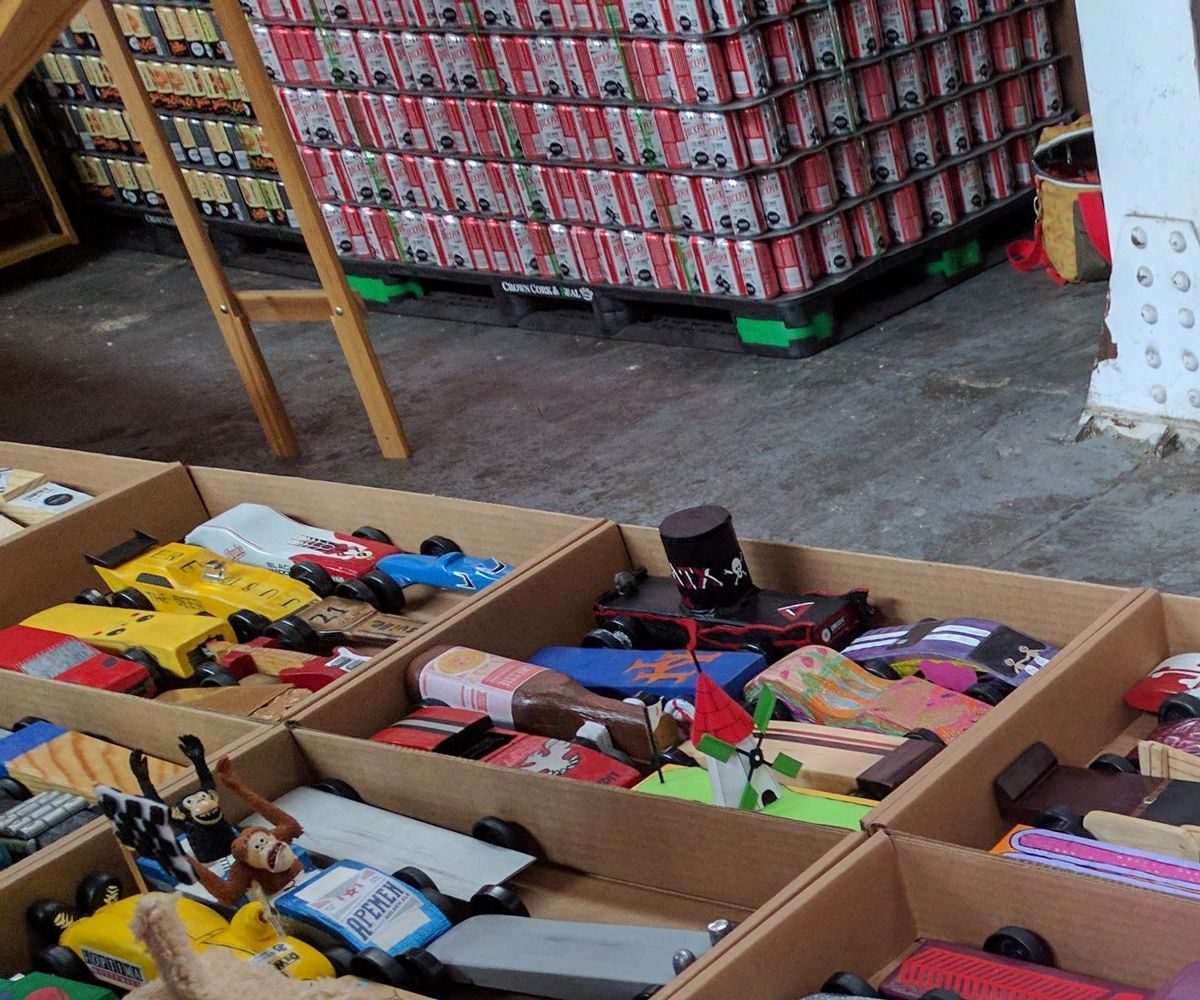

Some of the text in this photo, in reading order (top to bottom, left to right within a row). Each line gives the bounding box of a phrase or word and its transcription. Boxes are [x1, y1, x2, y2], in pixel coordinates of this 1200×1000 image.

[501, 281, 530, 293] CROWN
[530, 284, 551, 296] CORK
[266, 561, 291, 571] BLAC
[346, 879, 405, 941] APEMEN
